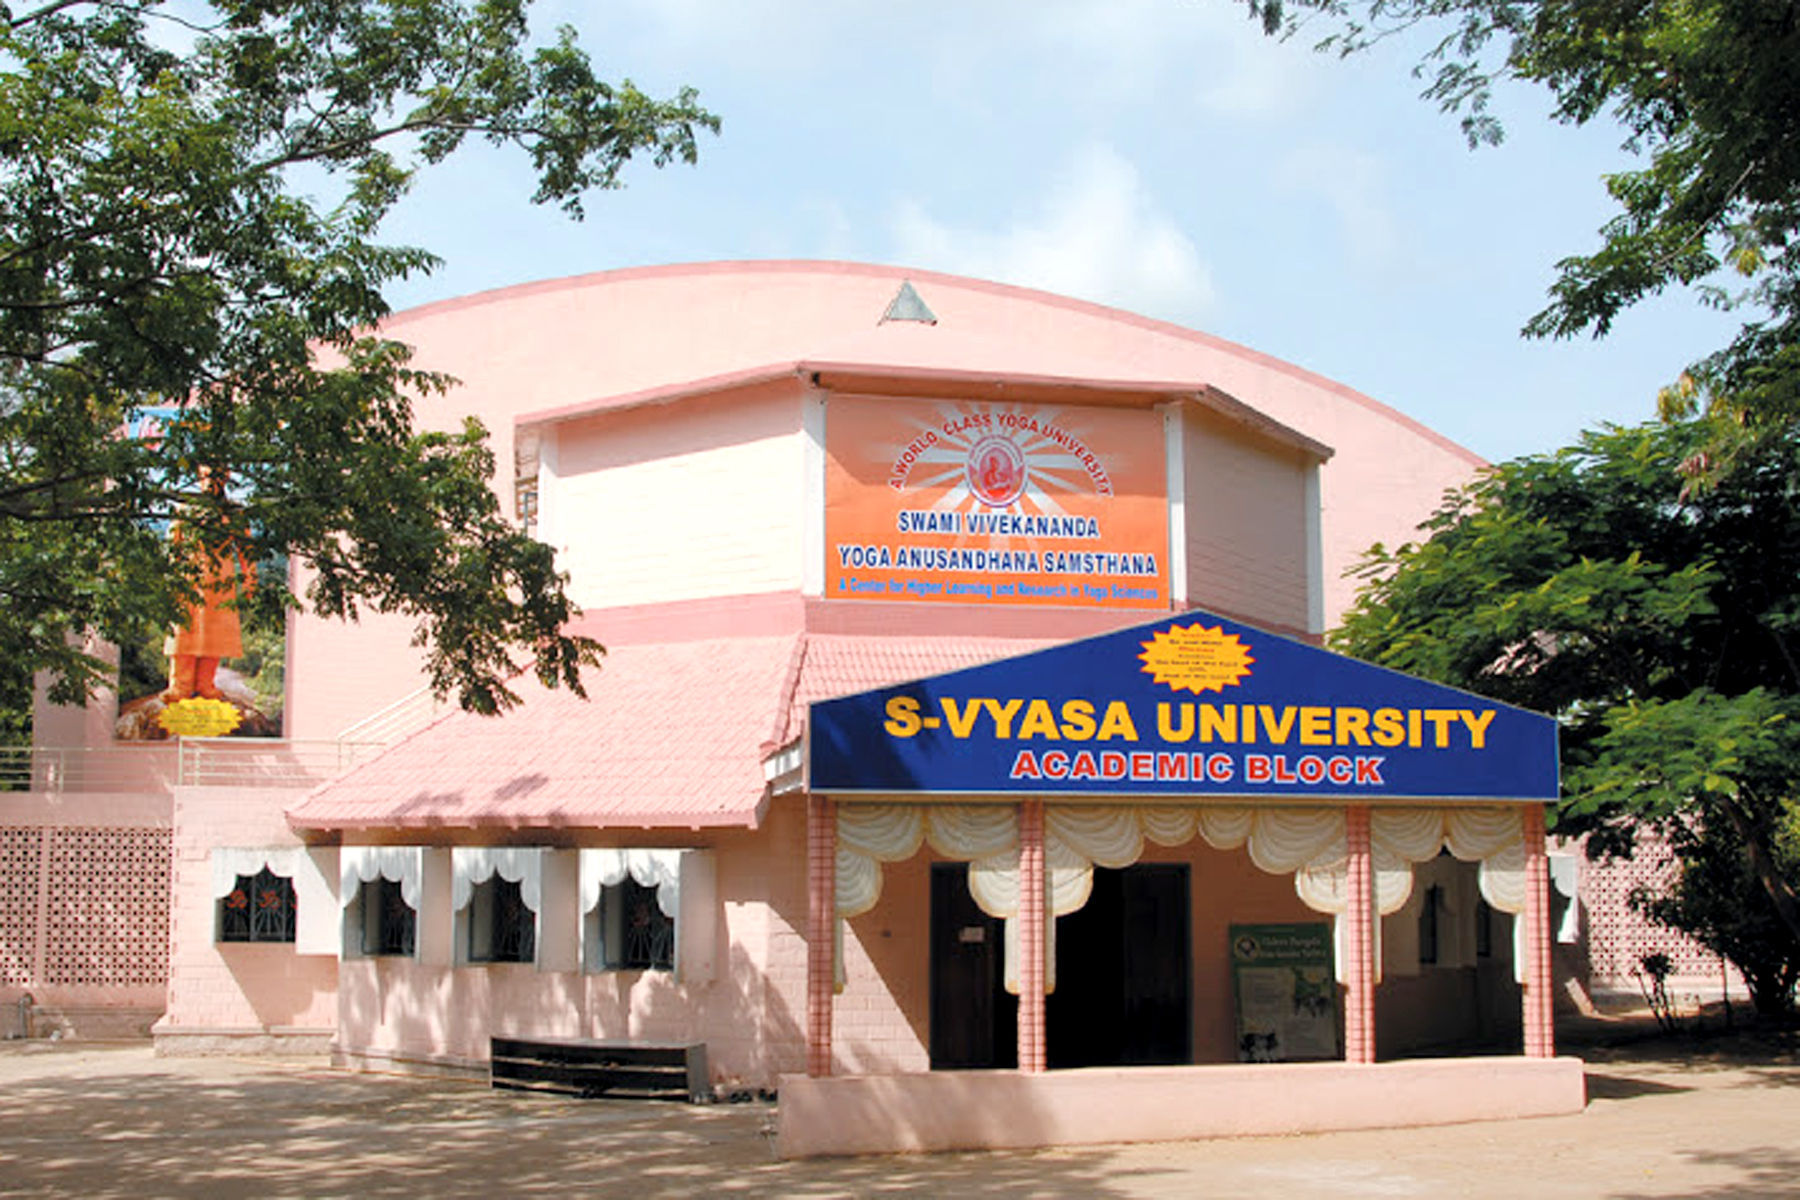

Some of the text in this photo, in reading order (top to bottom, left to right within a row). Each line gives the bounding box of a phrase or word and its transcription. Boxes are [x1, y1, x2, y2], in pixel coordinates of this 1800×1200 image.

[943, 413, 993, 436] CLASS
[996, 413, 1039, 433] YOGA
[1041, 424, 1111, 494] UNIVERSITY
[898, 511, 1100, 538] SWAMI VIVEKANANDA
[838, 546, 1158, 575] YOGA ANUSANDHANA SAMSTHANA
[906, 579, 943, 597] Higher
[946, 580, 993, 598] Learning
[1017, 582, 1067, 597] Research
[1083, 584, 1108, 602] Yoga
[883, 696, 1496, 750] S-VYASA UNIVERSITY
[1010, 750, 1386, 786] ACADEMIC BLOCK
